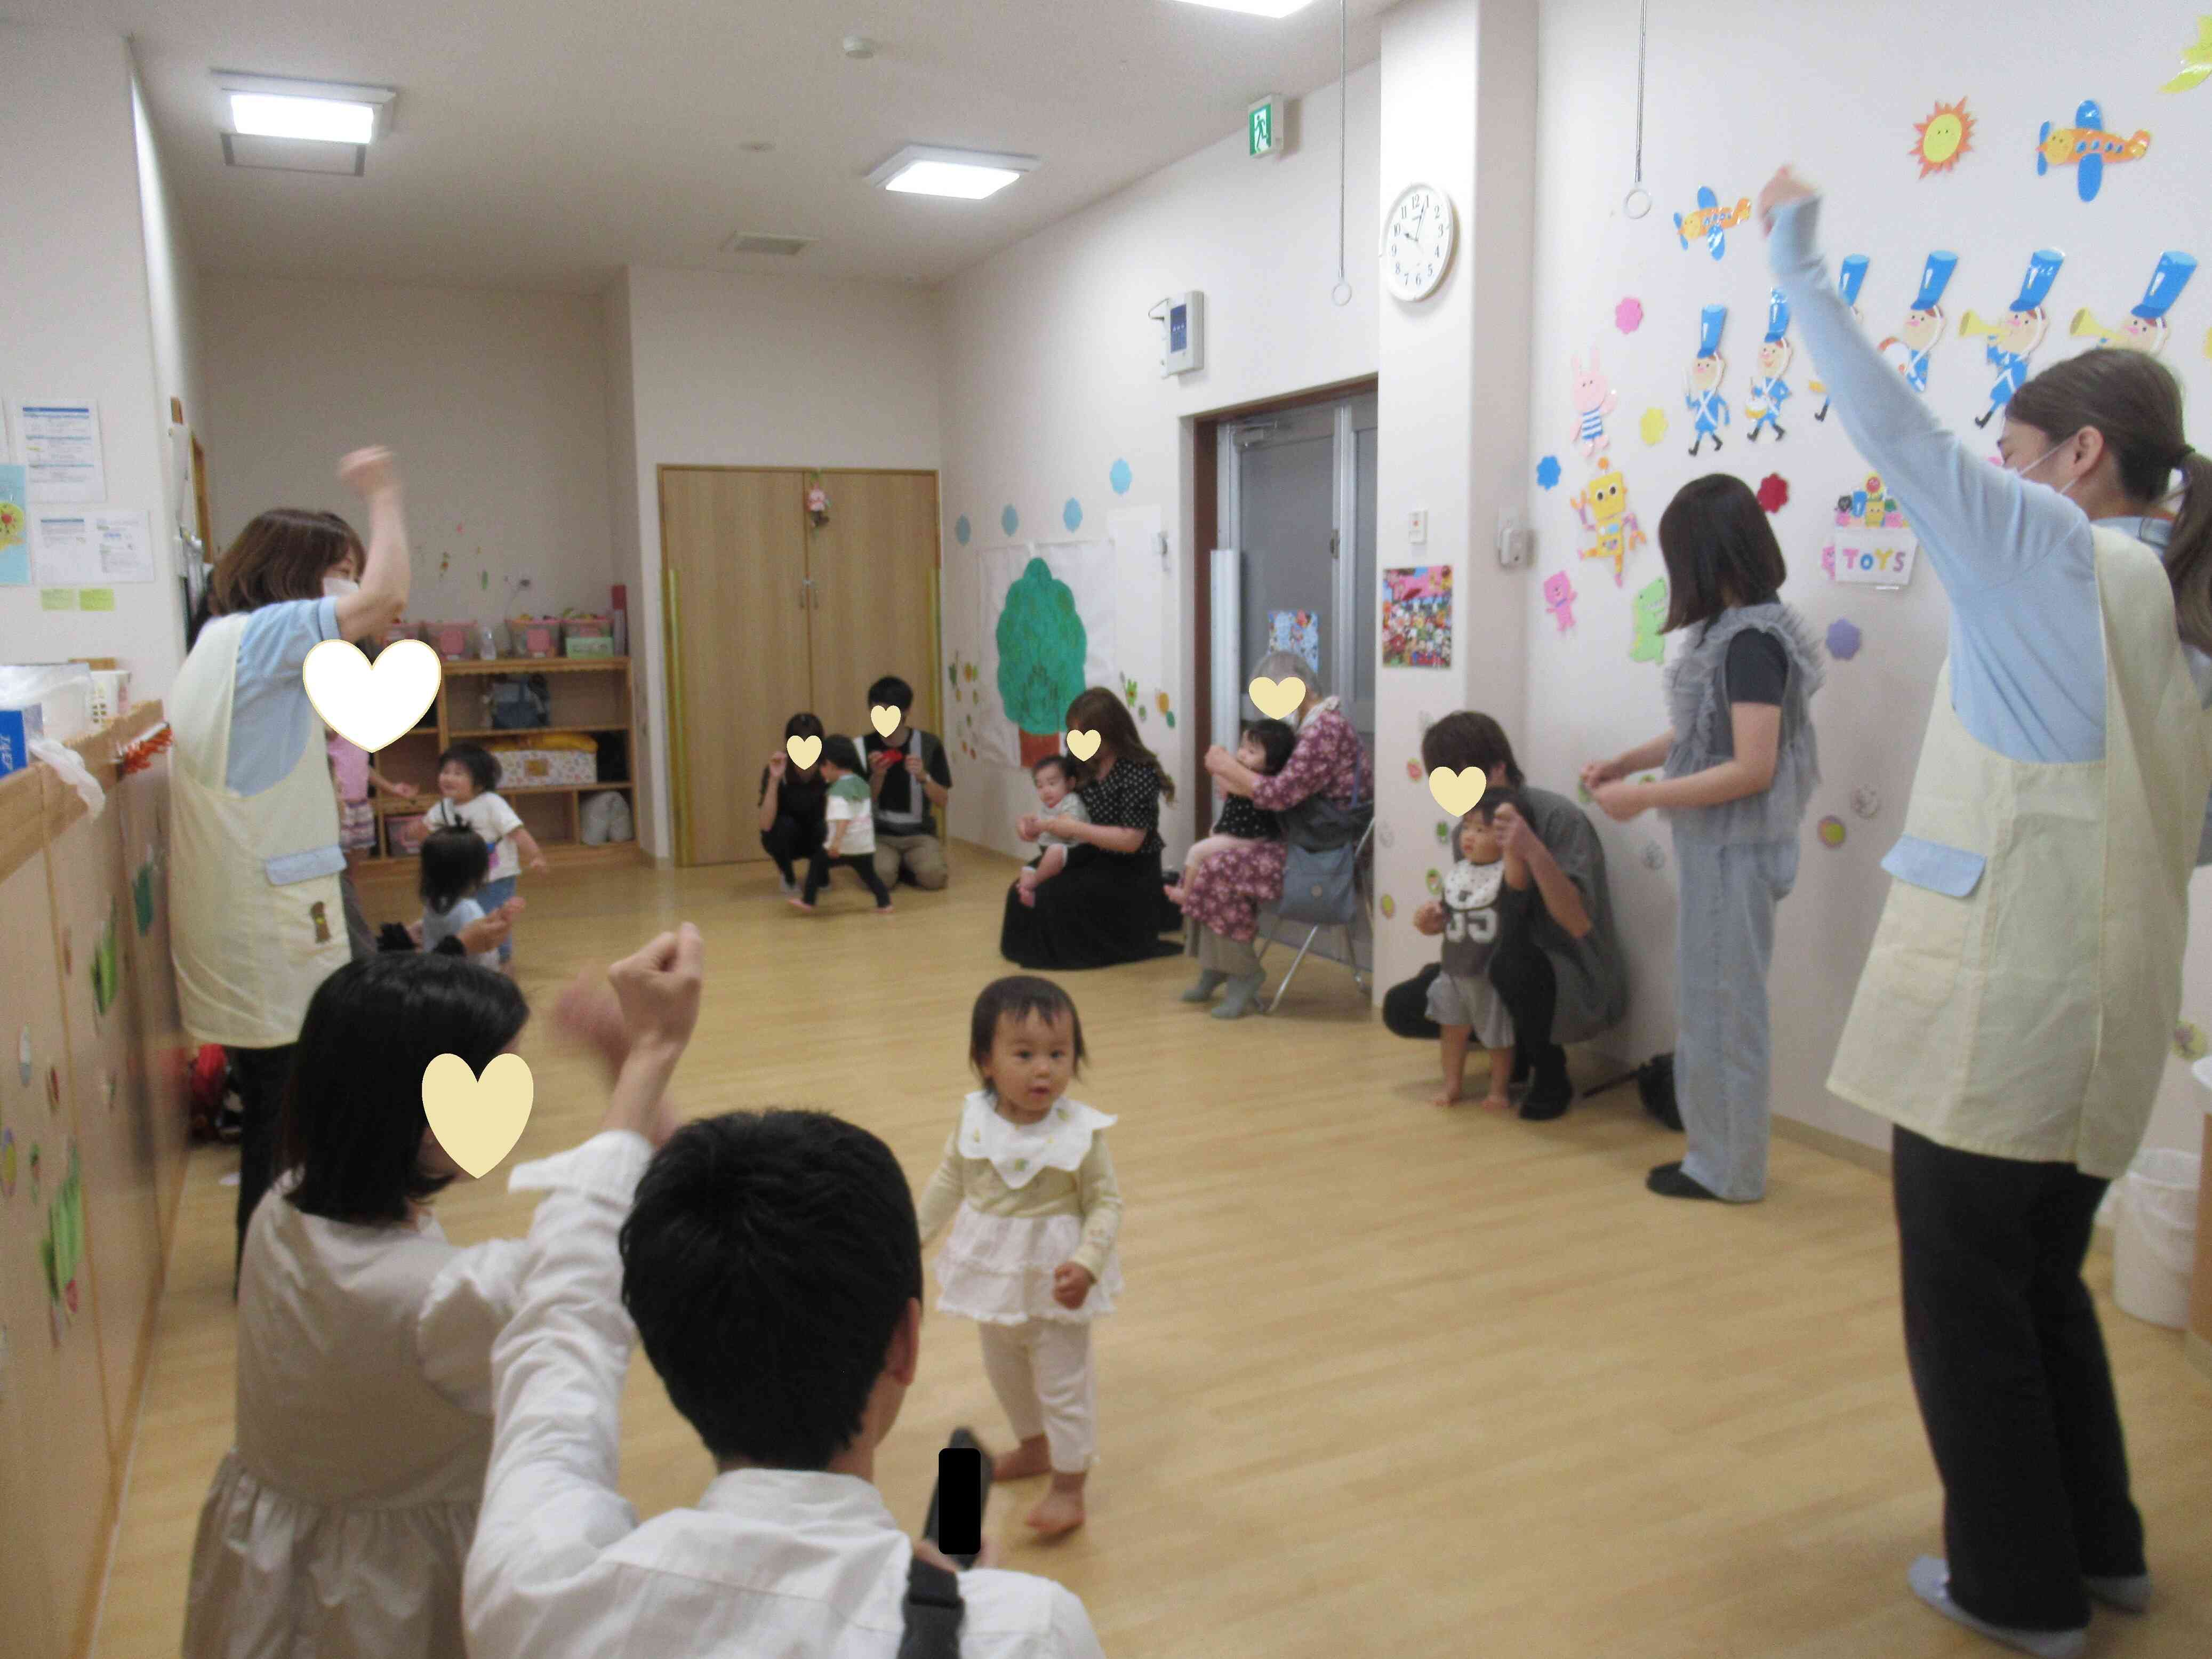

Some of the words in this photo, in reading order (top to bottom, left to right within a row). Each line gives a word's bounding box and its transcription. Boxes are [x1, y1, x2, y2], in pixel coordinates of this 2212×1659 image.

[1412, 194, 1420, 210] 12
[1426, 195, 1429, 207] 1
[1401, 205, 1407, 219] 11
[1434, 205, 1439, 219] 2
[1394, 223, 1401, 237] 10
[1439, 224, 1444, 238] 3
[1391, 244, 1397, 257] 9
[1434, 244, 1439, 258] 4
[1396, 262, 1400, 274] 8
[1428, 263, 1433, 276] 5
[1404, 273, 1409, 286] 7
[1416, 274, 1421, 286] 6
[1843, 548, 1906, 572] TOYS
